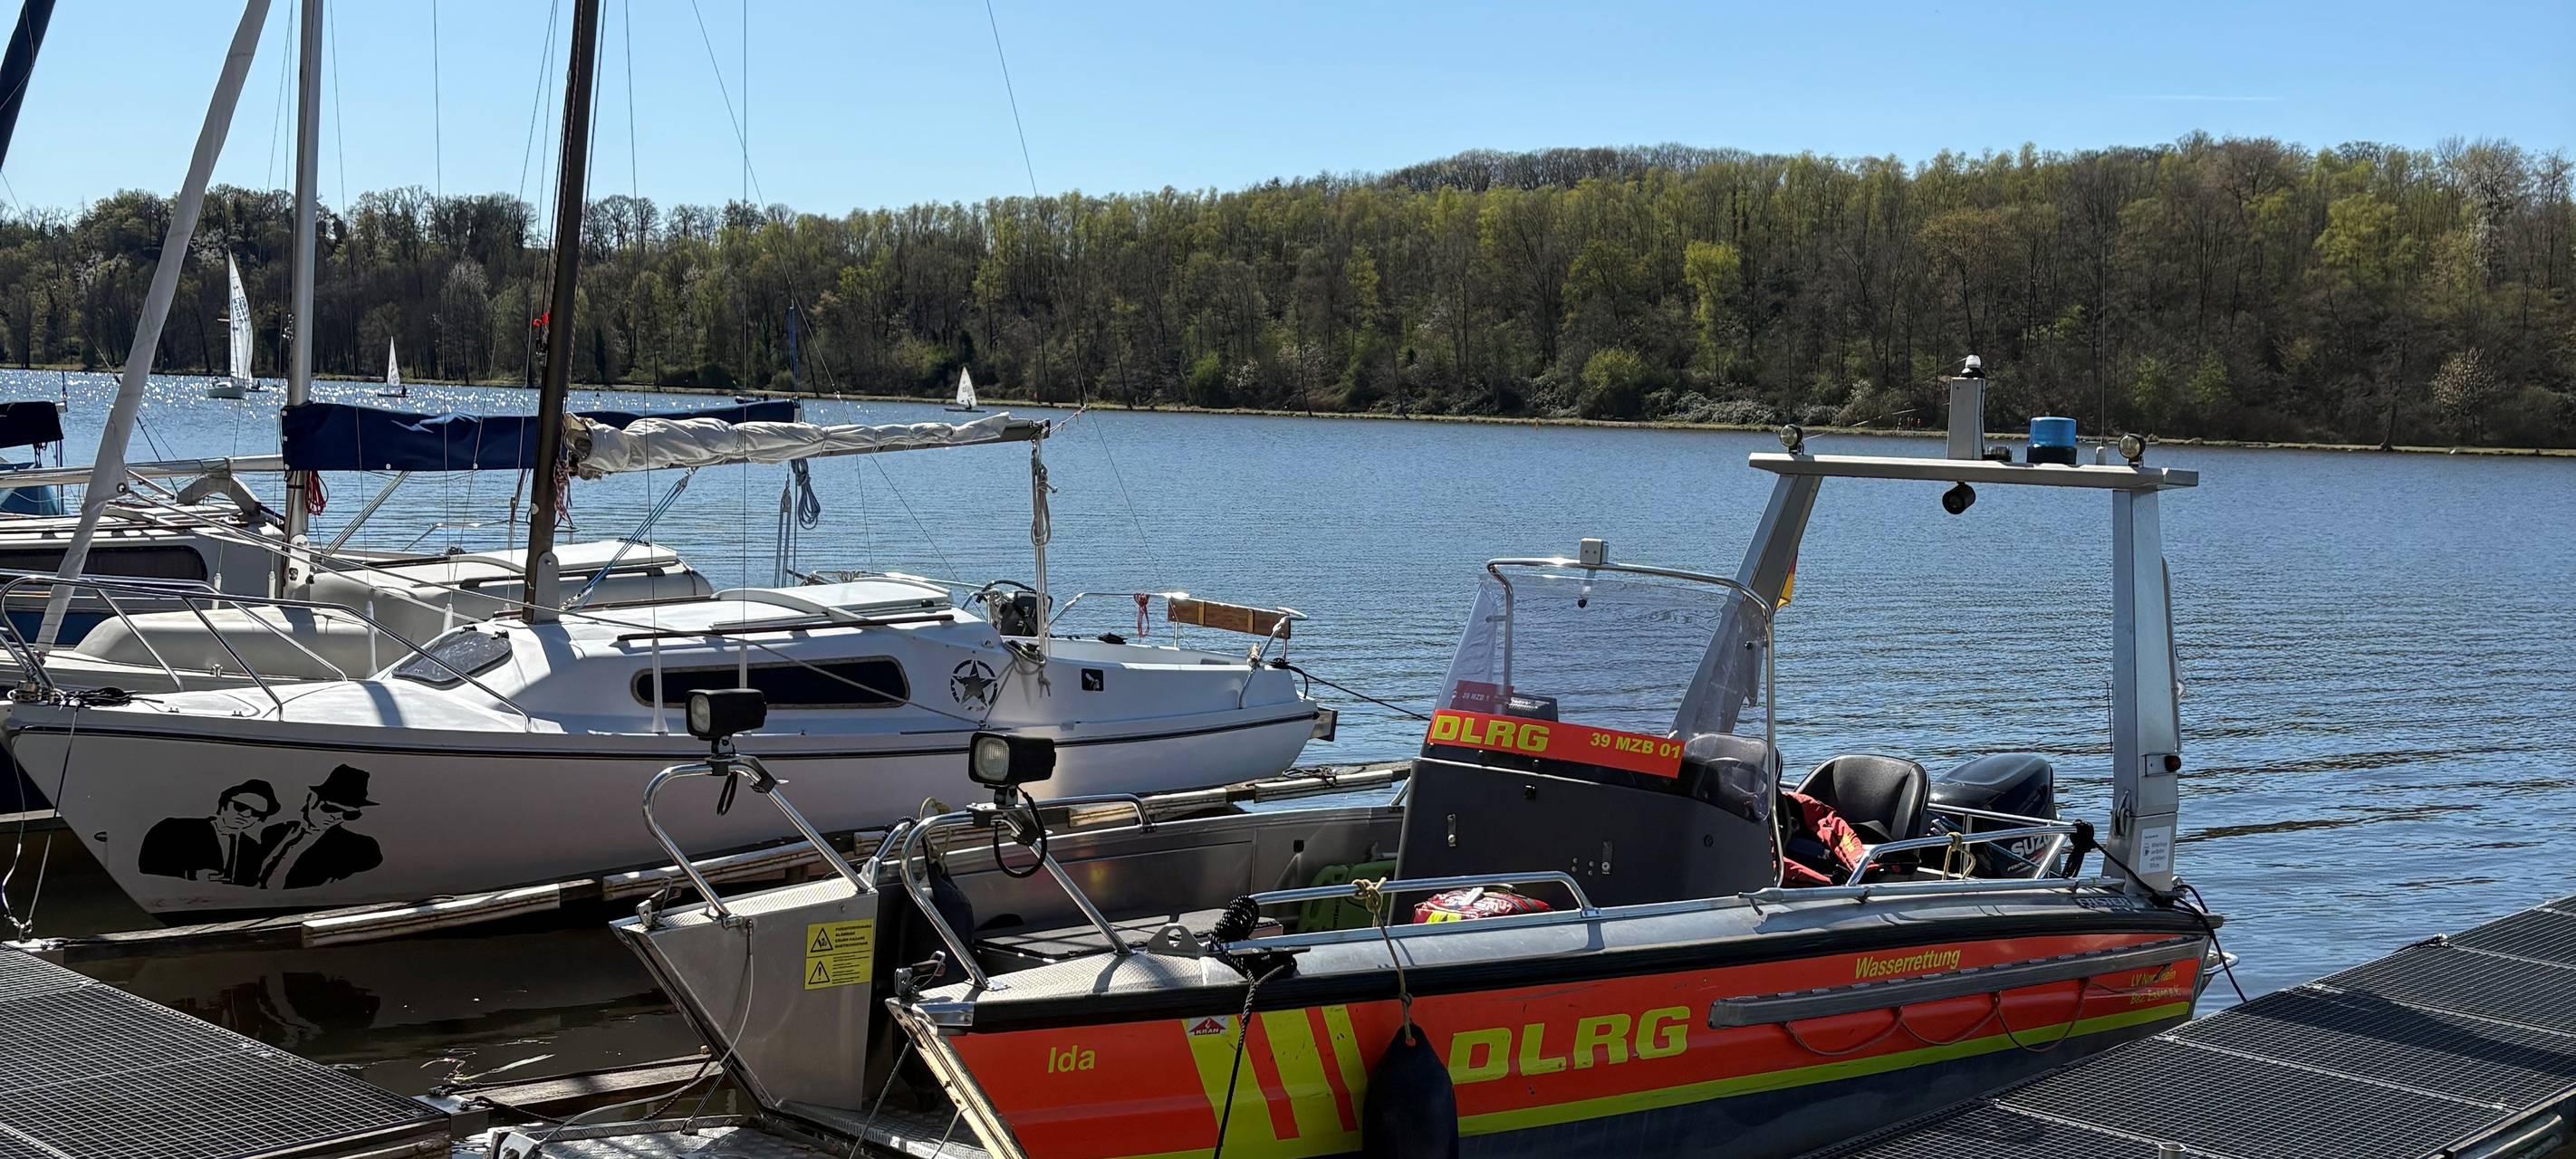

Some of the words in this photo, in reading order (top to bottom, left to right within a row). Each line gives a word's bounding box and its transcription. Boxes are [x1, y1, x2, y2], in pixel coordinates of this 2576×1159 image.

[1431, 714, 1551, 752] DLRG
[1591, 732, 1610, 748] 39
[1615, 735, 1654, 754] MZB
[1659, 742, 1681, 759] 01
[1854, 949, 1962, 979] Wasserrettung
[1048, 1044, 1096, 1073] Ida
[1448, 1005, 1691, 1085] DLRG
